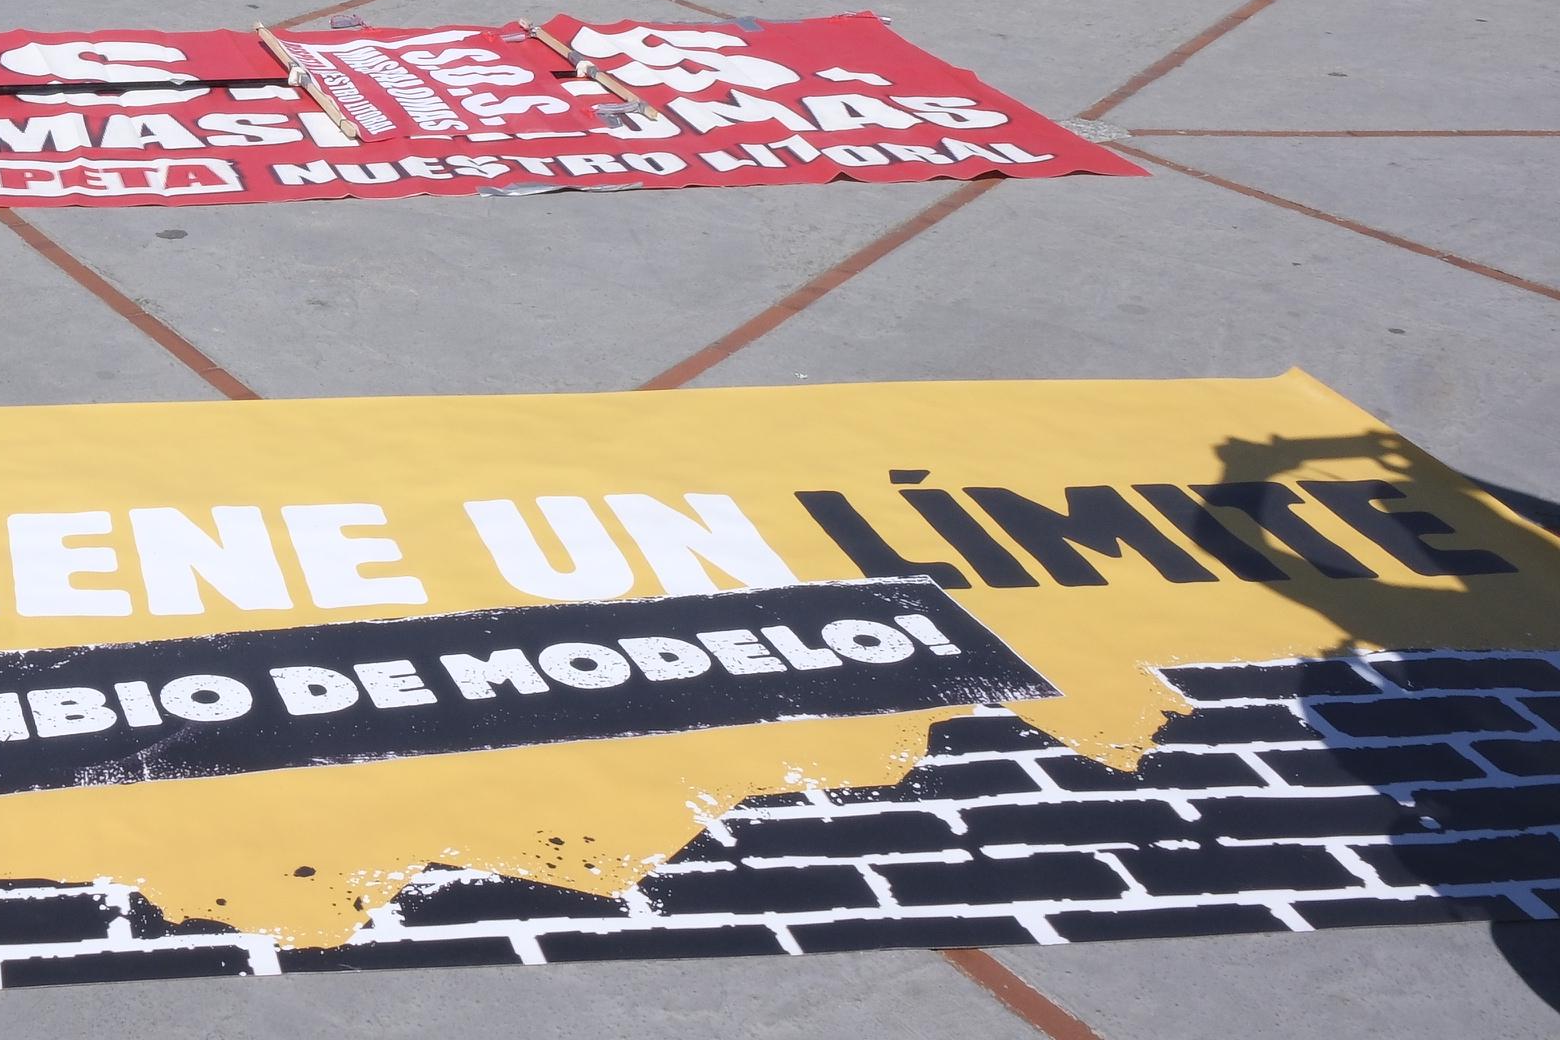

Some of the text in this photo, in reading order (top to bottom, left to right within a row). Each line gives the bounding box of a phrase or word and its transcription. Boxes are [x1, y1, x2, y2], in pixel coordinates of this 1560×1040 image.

[273, 152, 689, 186] NUESTRO
[699, 133, 1056, 173] LITORAL
[462, 492, 799, 602] UN
[793, 469, 1520, 590] LÍMITE
[268, 659, 437, 717] DE
[443, 613, 963, 701] MODELO!
